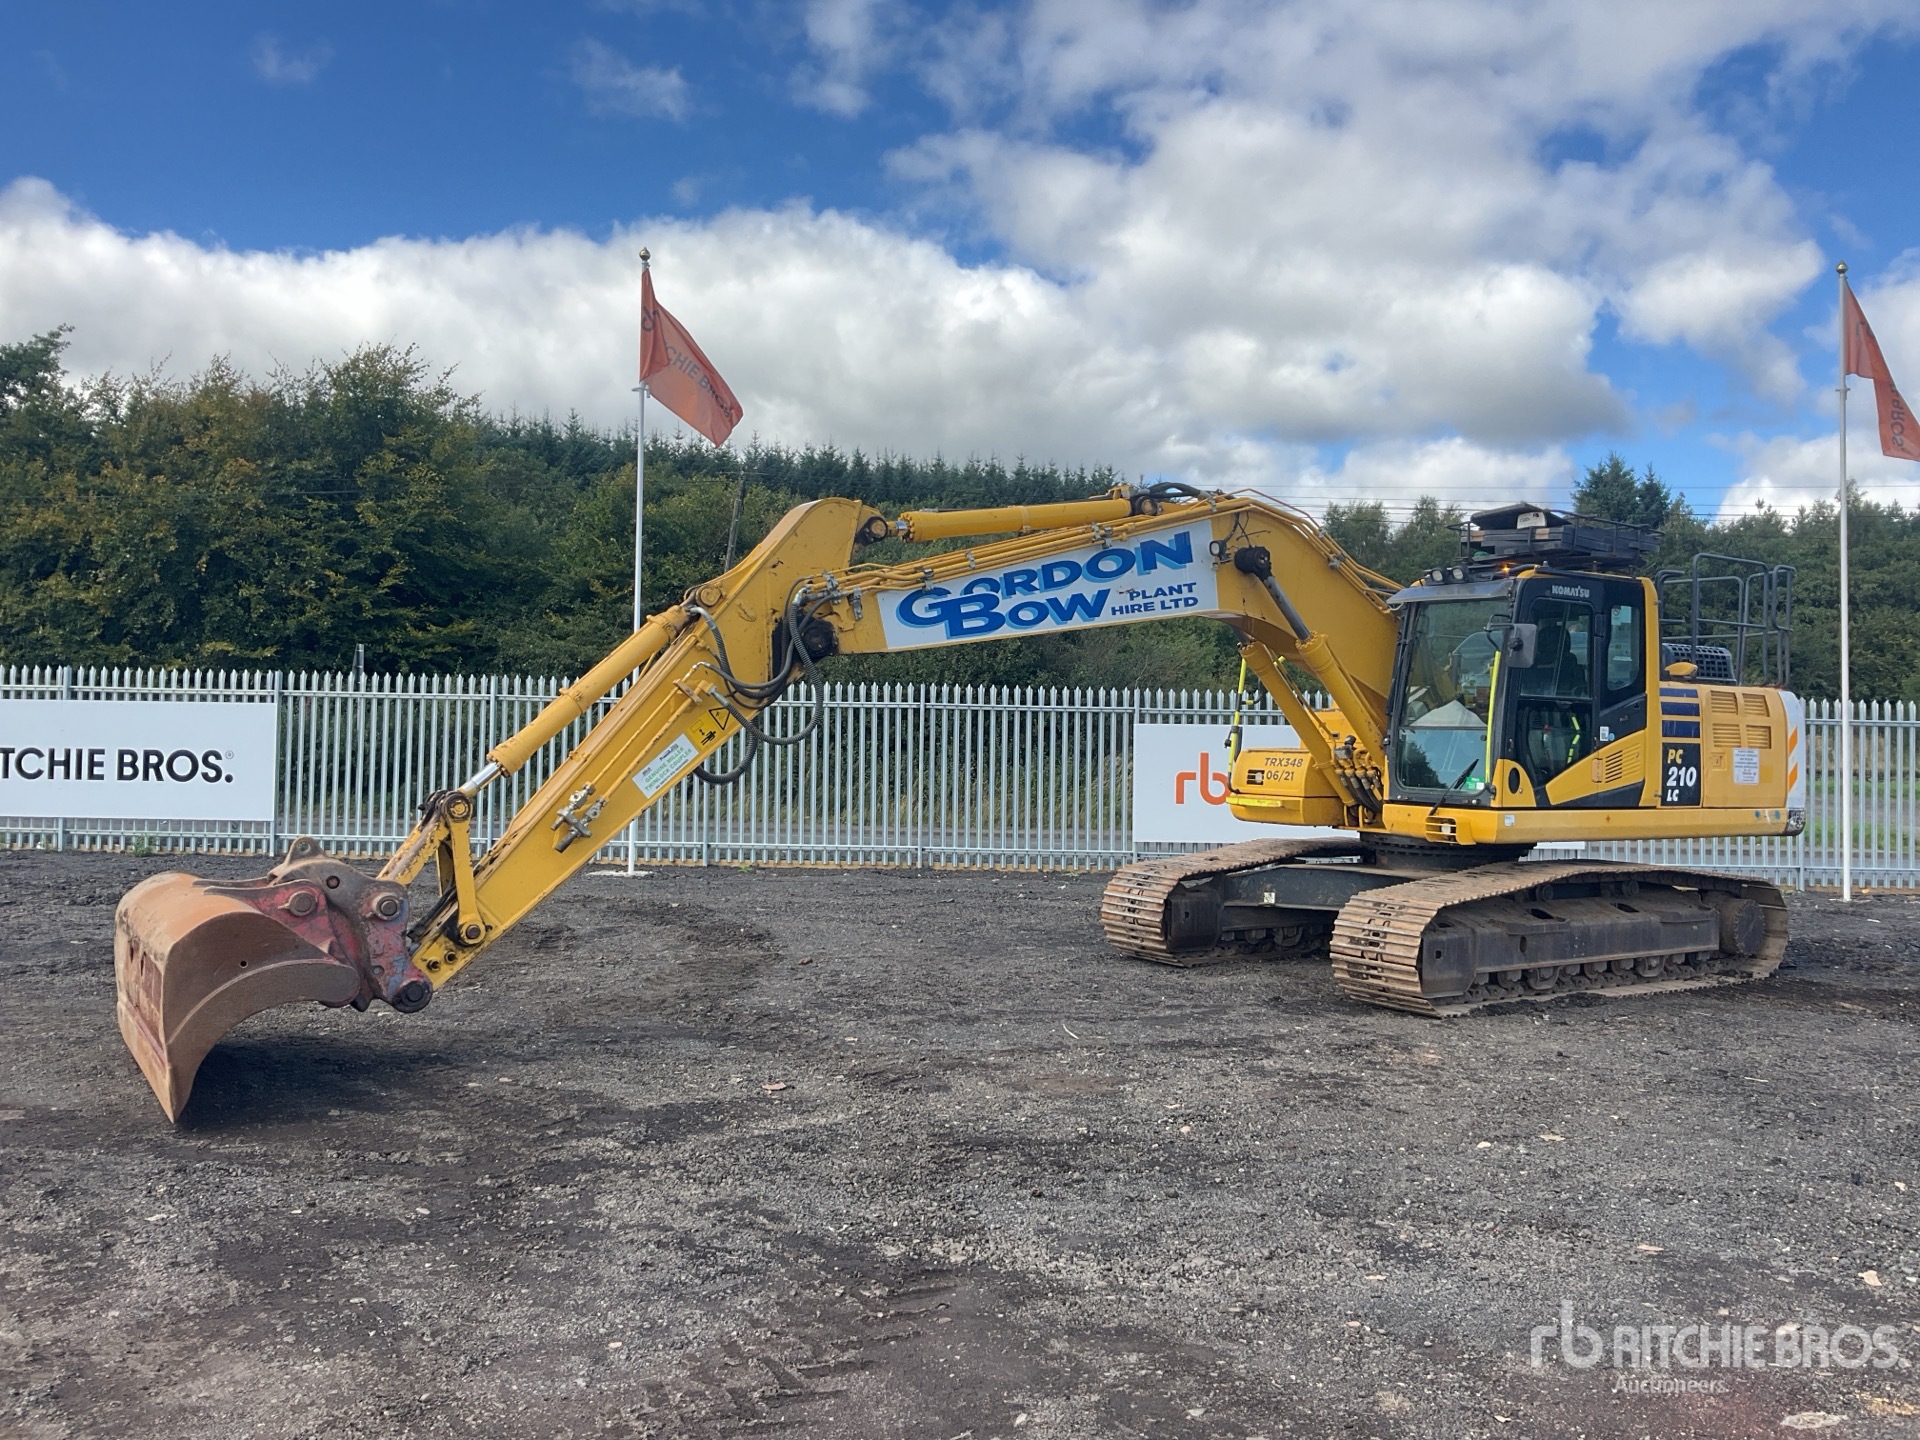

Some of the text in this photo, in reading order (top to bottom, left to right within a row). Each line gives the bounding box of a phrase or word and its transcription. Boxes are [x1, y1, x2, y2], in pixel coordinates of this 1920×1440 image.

[896, 531, 1195, 628] GORDON
[1128, 582, 1197, 601] PLANT
[1551, 585, 1590, 598] KOMATSU
[946, 588, 1112, 640] BOW
[1111, 596, 1199, 616] HIRE LTD
[117, 749, 234, 783] BROS.
[1264, 757, 1304, 768] TRX348
[1667, 749, 1684, 764] PC
[1266, 770, 1295, 782] 06/21
[1666, 766, 1697, 787] 210
[1666, 789, 1680, 801] LC
